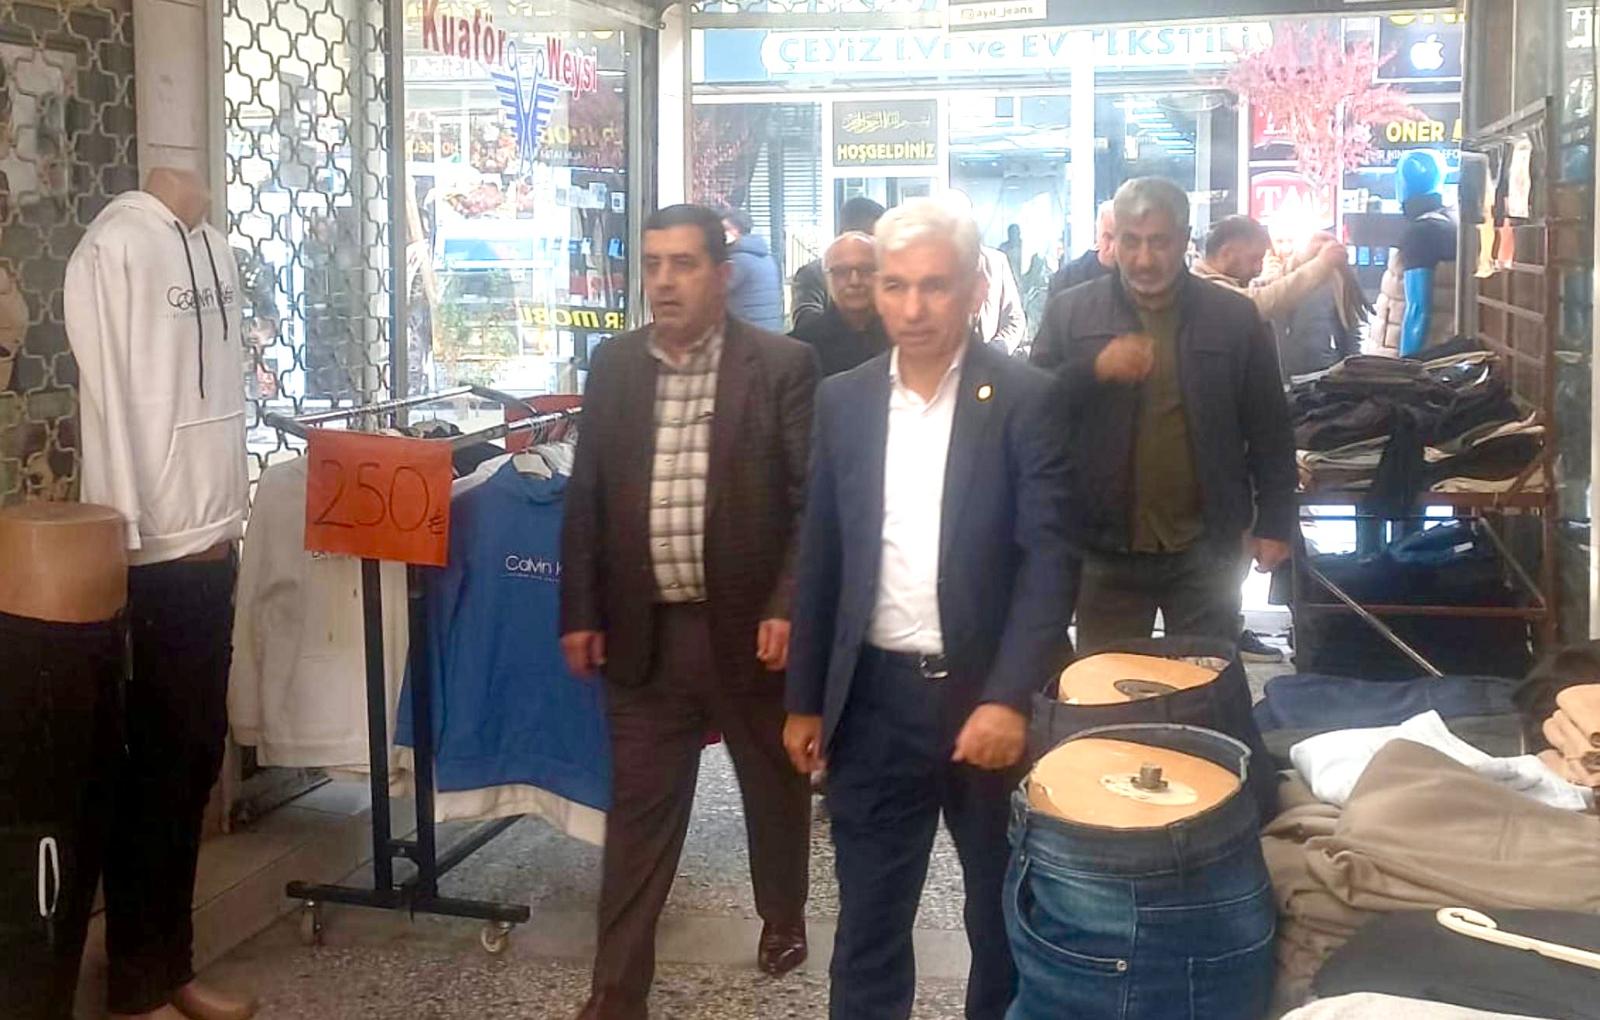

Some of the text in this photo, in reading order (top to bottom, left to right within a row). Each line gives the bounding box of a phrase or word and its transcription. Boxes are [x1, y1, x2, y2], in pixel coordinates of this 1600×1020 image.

[422, 0, 597, 100] Kuaför Weysi
[837, 140, 935, 163] HOŞGELDİNİZ
